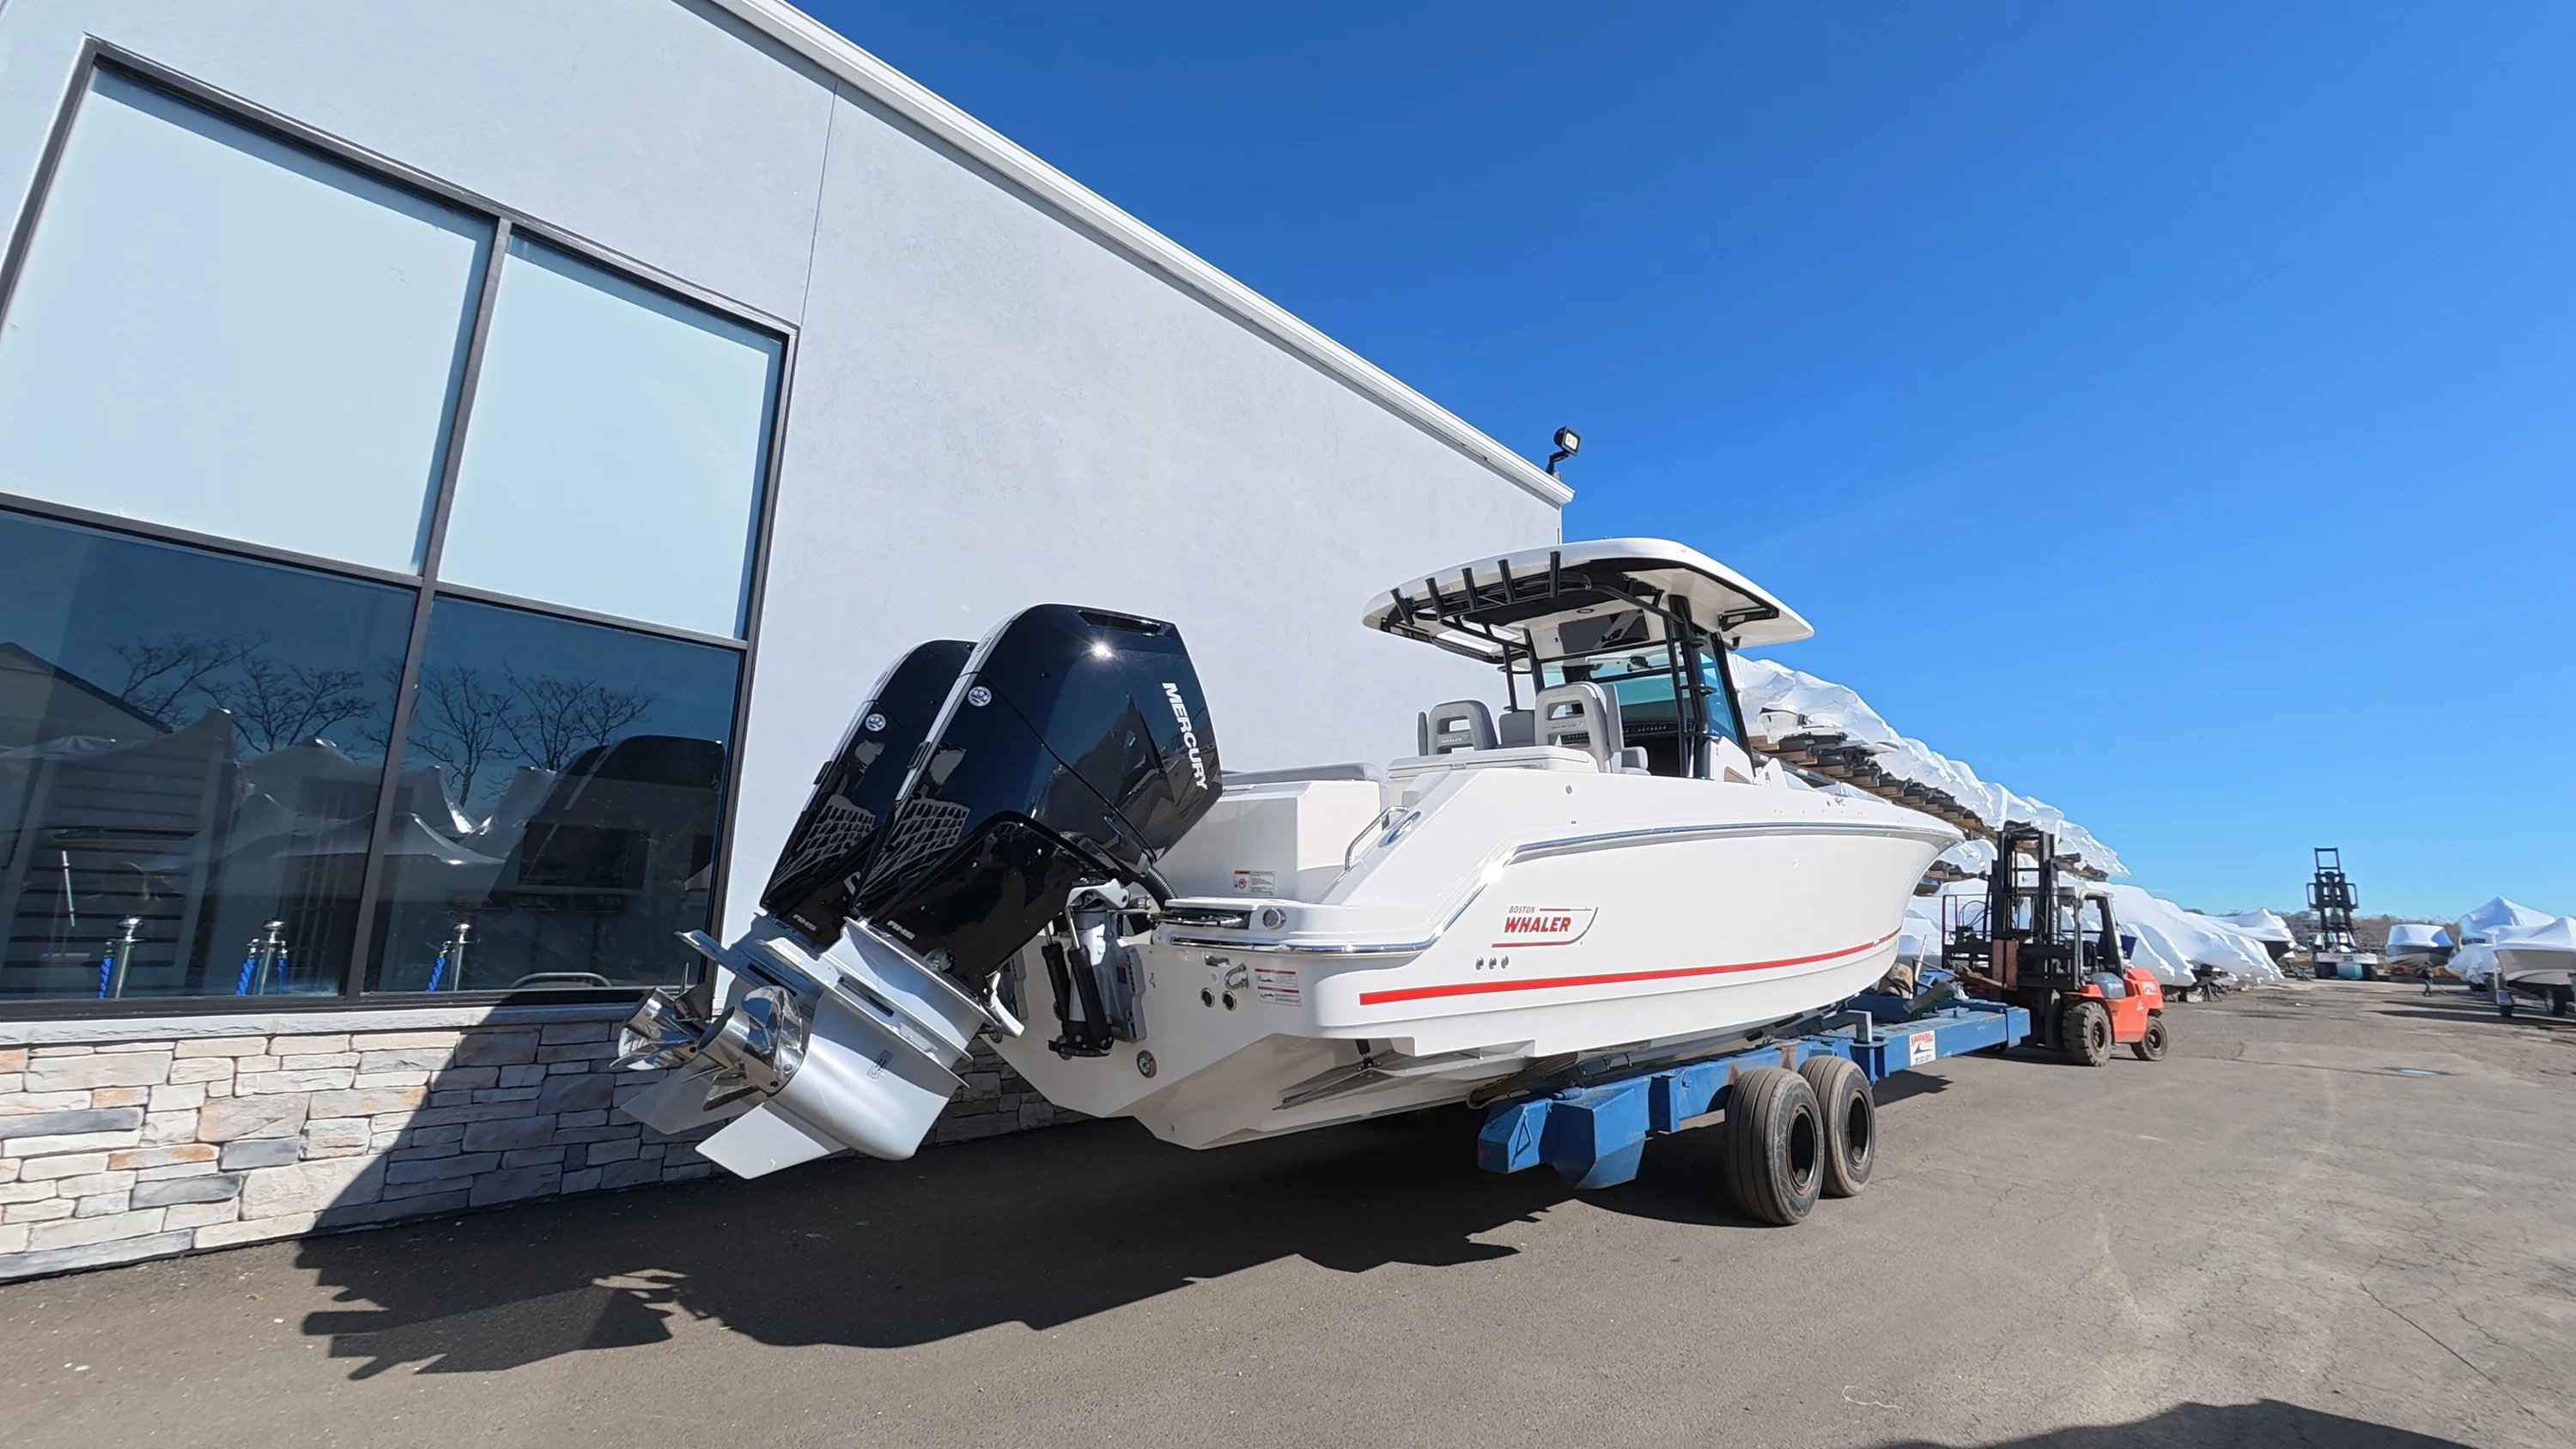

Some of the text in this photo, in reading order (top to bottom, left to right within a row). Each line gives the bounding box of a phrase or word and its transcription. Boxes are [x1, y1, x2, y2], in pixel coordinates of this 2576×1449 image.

[1162, 682, 1207, 791] MERCURY
[1509, 906, 1535, 914] BOSTON
[1504, 917, 1571, 933] WHALER
